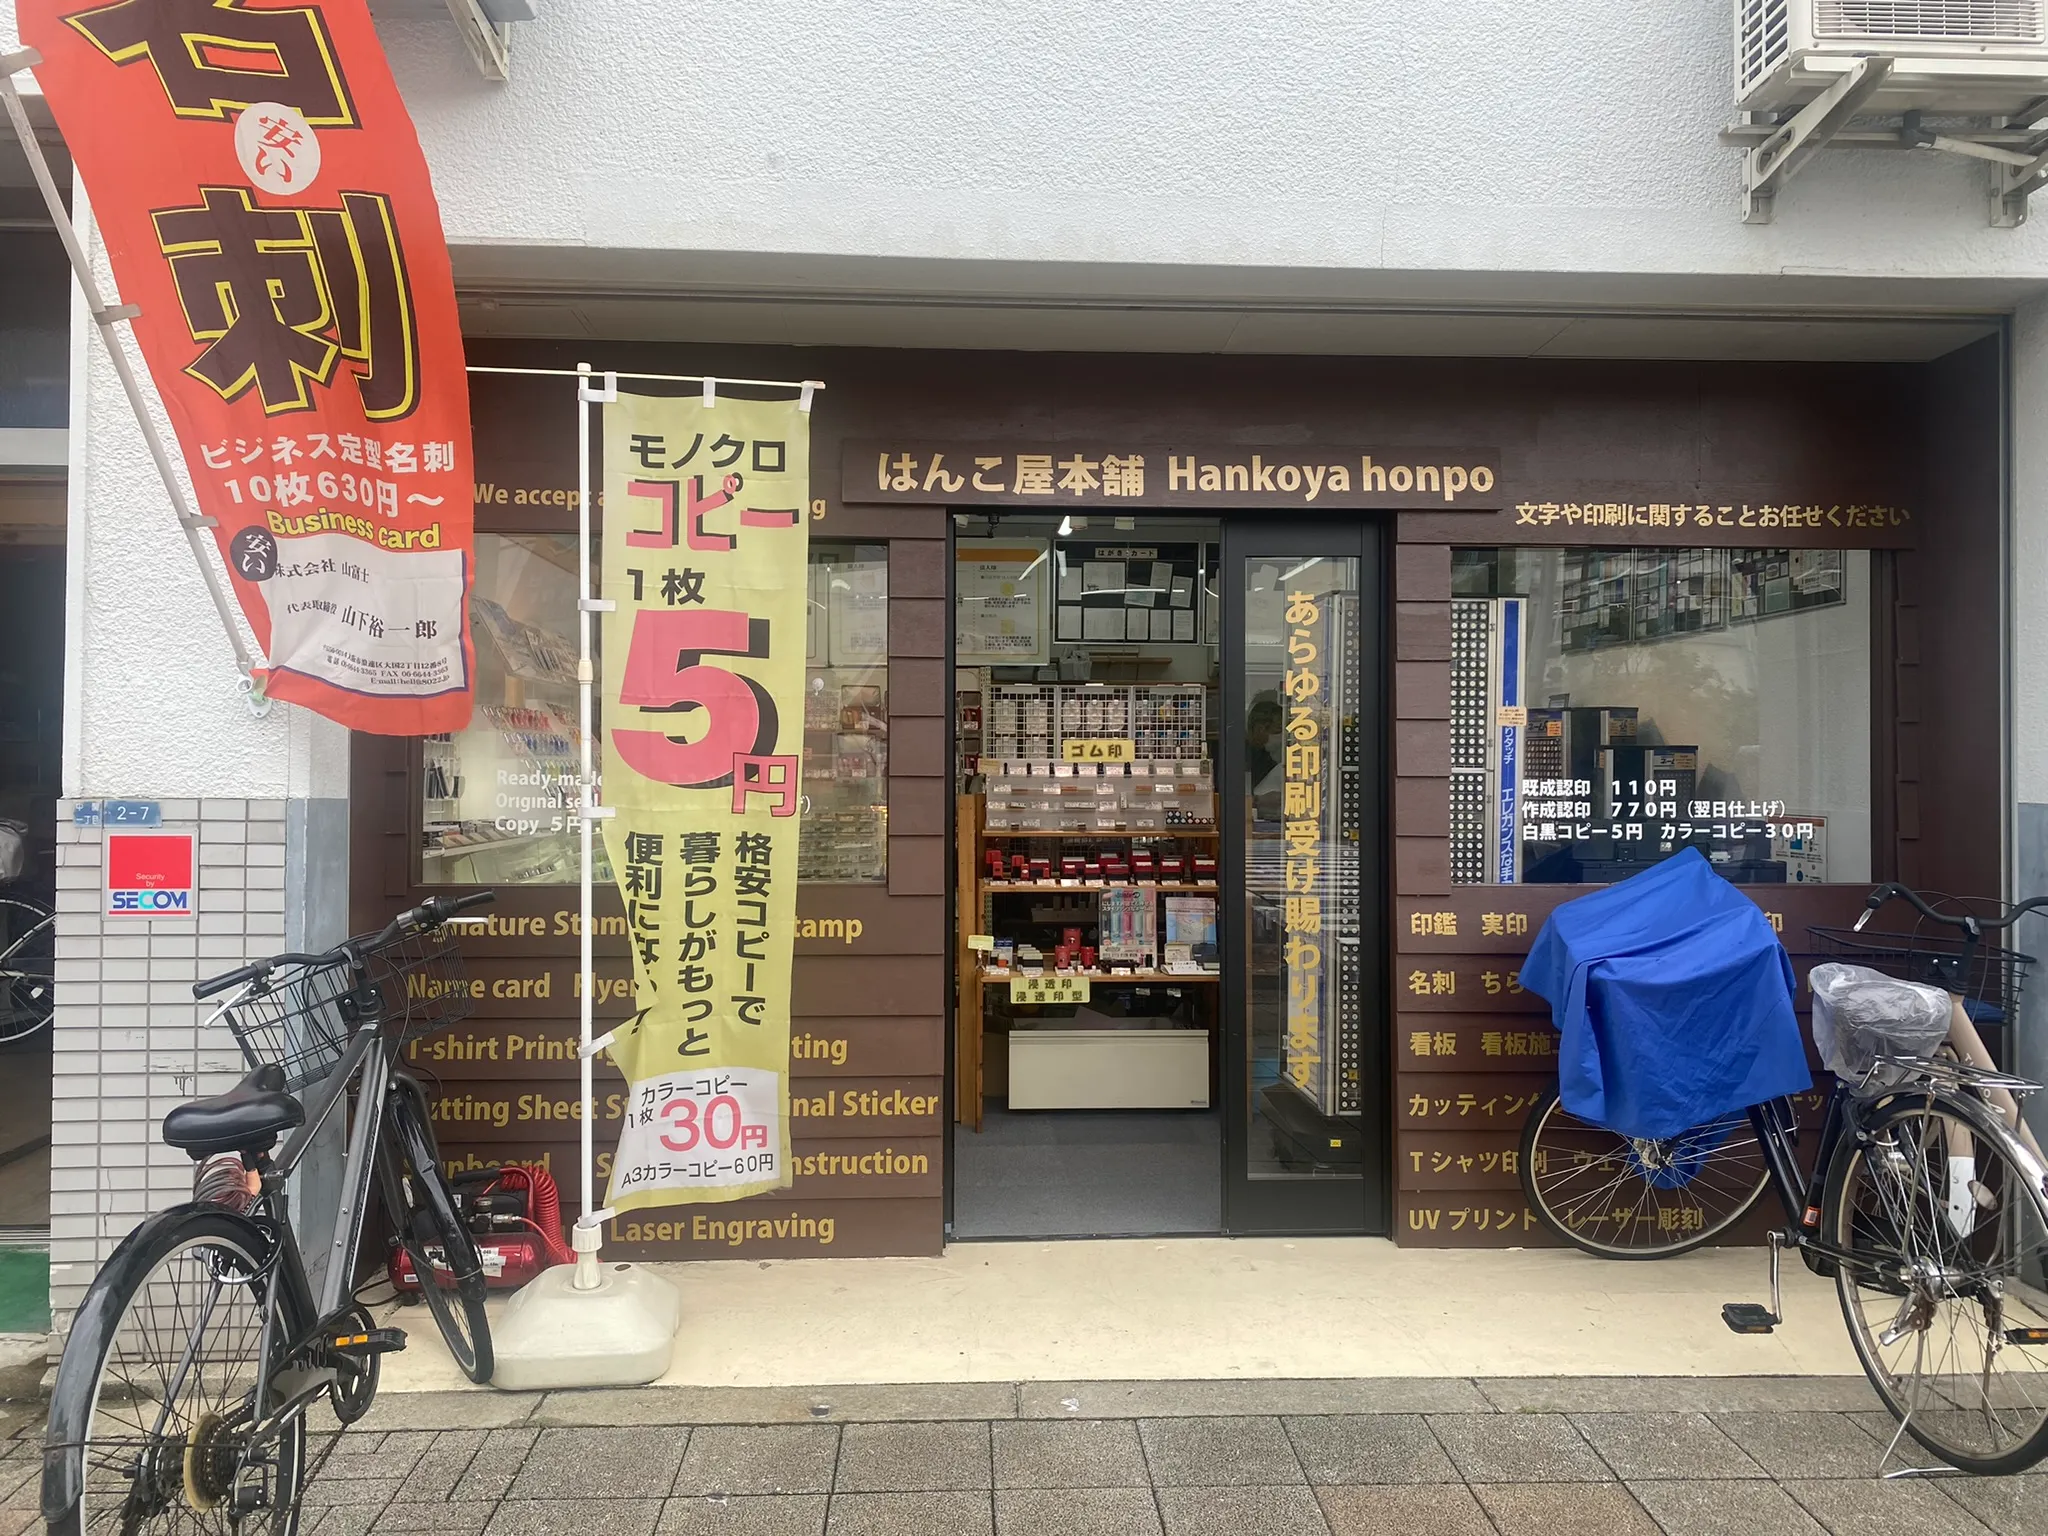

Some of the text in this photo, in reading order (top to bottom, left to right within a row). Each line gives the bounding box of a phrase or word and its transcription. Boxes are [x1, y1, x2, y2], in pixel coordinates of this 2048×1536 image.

[255, 115, 304, 183] 安い
[200, 432, 455, 474] ビジネス定型名刺
[629, 433, 786, 472] モノクロ
[878, 452, 1495, 502] はんこ屋本舗 Hankoya honpo
[474, 483, 509, 504] We
[513, 488, 592, 511] accep
[626, 472, 800, 552] コピー
[265, 506, 442, 549] Business card
[1515, 501, 1911, 528] 文字や印刷に関することお任せください
[241, 533, 272, 575] 安い
[626, 567, 706, 606] 1枚
[380, 669, 400, 678] FAX
[611, 608, 800, 818] 5円
[1070, 744, 1123, 758] ゴム印
[565, 792, 599, 809] sel
[1521, 779, 1677, 797] 既成認印 110円
[117, 805, 150, 821] 2-7
[1521, 800, 1591, 820] 作成認印
[494, 815, 540, 836] Copy
[1284, 590, 1321, 1089] あらゆる印刷受け賜わります
[1500, 788, 1514, 885] エレガンスな手
[1521, 822, 1814, 841] 白黒コピー5円 カラーコピー30円
[135, 872, 165, 881] Security
[145, 880, 155, 888] by
[113, 890, 187, 909] SECOM
[731, 831, 773, 1026] 格安コピーで
[793, 914, 863, 944] tamp
[1410, 912, 1458, 936] 印鑑
[1481, 912, 1528, 936] 実印
[677, 832, 721, 1057] 暮らしがもっと
[492, 972, 551, 998] card
[1409, 970, 1526, 995] 名刺 ちら
[792, 1033, 848, 1065] ting
[1410, 1031, 1457, 1056] 看板
[641, 1074, 749, 1107] カラーコピー
[431, 1094, 510, 1128] tting
[842, 1089, 939, 1117] Sticker
[628, 1106, 655, 1130] 1枚
[659, 1094, 768, 1152] 30円
[621, 1152, 774, 1189] A3カラーコピー60円
[792, 1148, 929, 1178] nstruction
[610, 1212, 835, 1247] Laser Engraving
